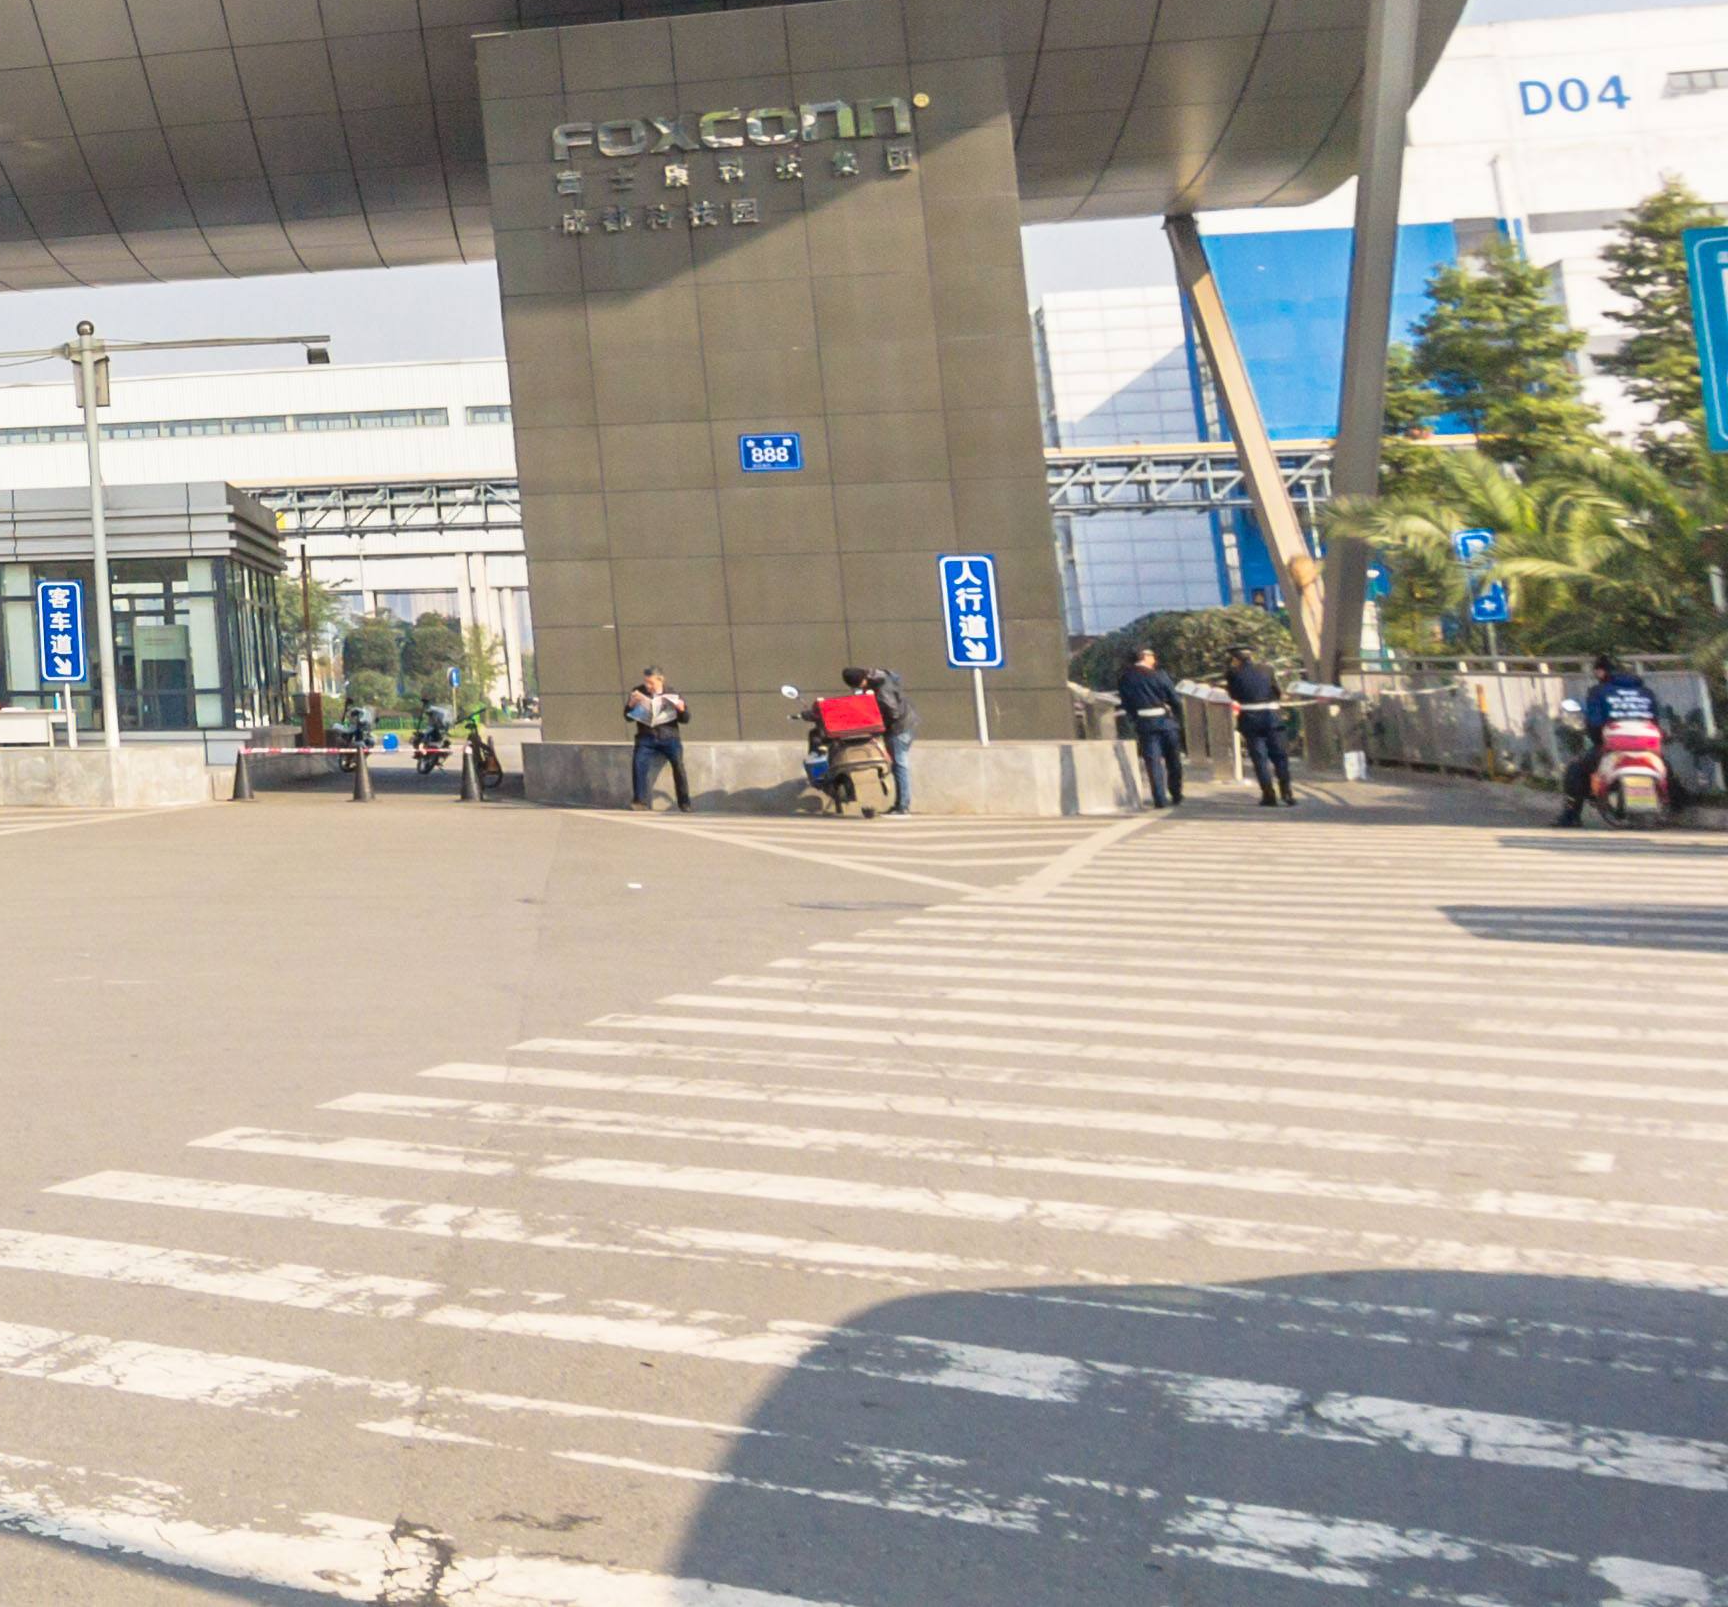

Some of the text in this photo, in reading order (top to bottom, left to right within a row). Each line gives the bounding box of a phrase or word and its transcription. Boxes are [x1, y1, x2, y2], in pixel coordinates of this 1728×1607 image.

[752, 447, 789, 462] 888
[48, 588, 73, 655] 客车道
[954, 561, 989, 638] 人行道
